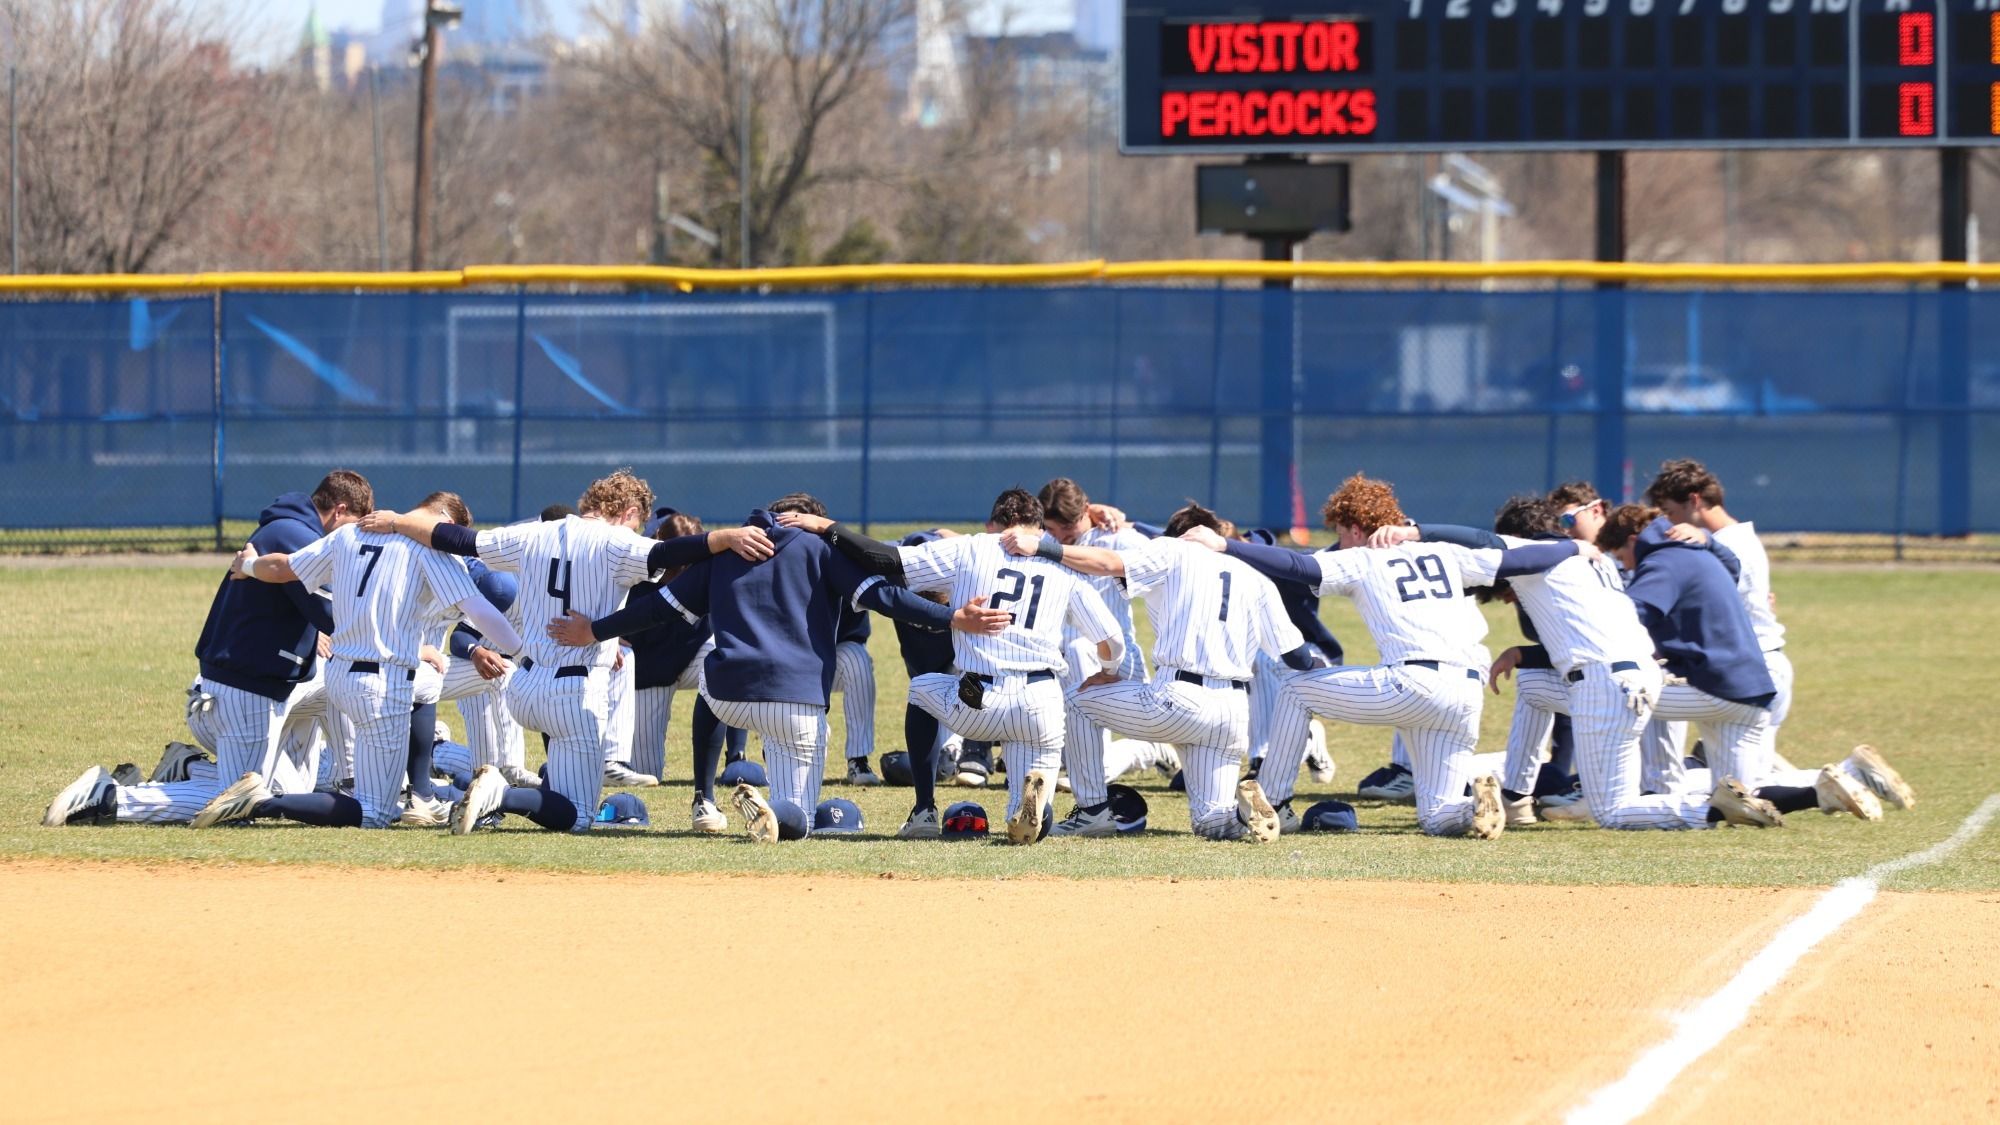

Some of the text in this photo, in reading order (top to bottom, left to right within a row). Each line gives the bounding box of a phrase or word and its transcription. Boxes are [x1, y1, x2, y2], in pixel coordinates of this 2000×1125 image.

[1445, 0, 1470, 18] 2
[1491, 0, 1517, 18] 3
[1536, 0, 1562, 17] 4
[1188, 21, 1359, 72] VISITOR
[1899, 12, 1933, 65] 0
[1161, 88, 1377, 136] PEACOCKS
[1899, 82, 1934, 135] 0
[357, 544, 384, 597] 7
[547, 557, 572, 616] 4
[1218, 570, 1231, 622] 1
[1386, 554, 1453, 602] 29
[990, 568, 1045, 630] 21
